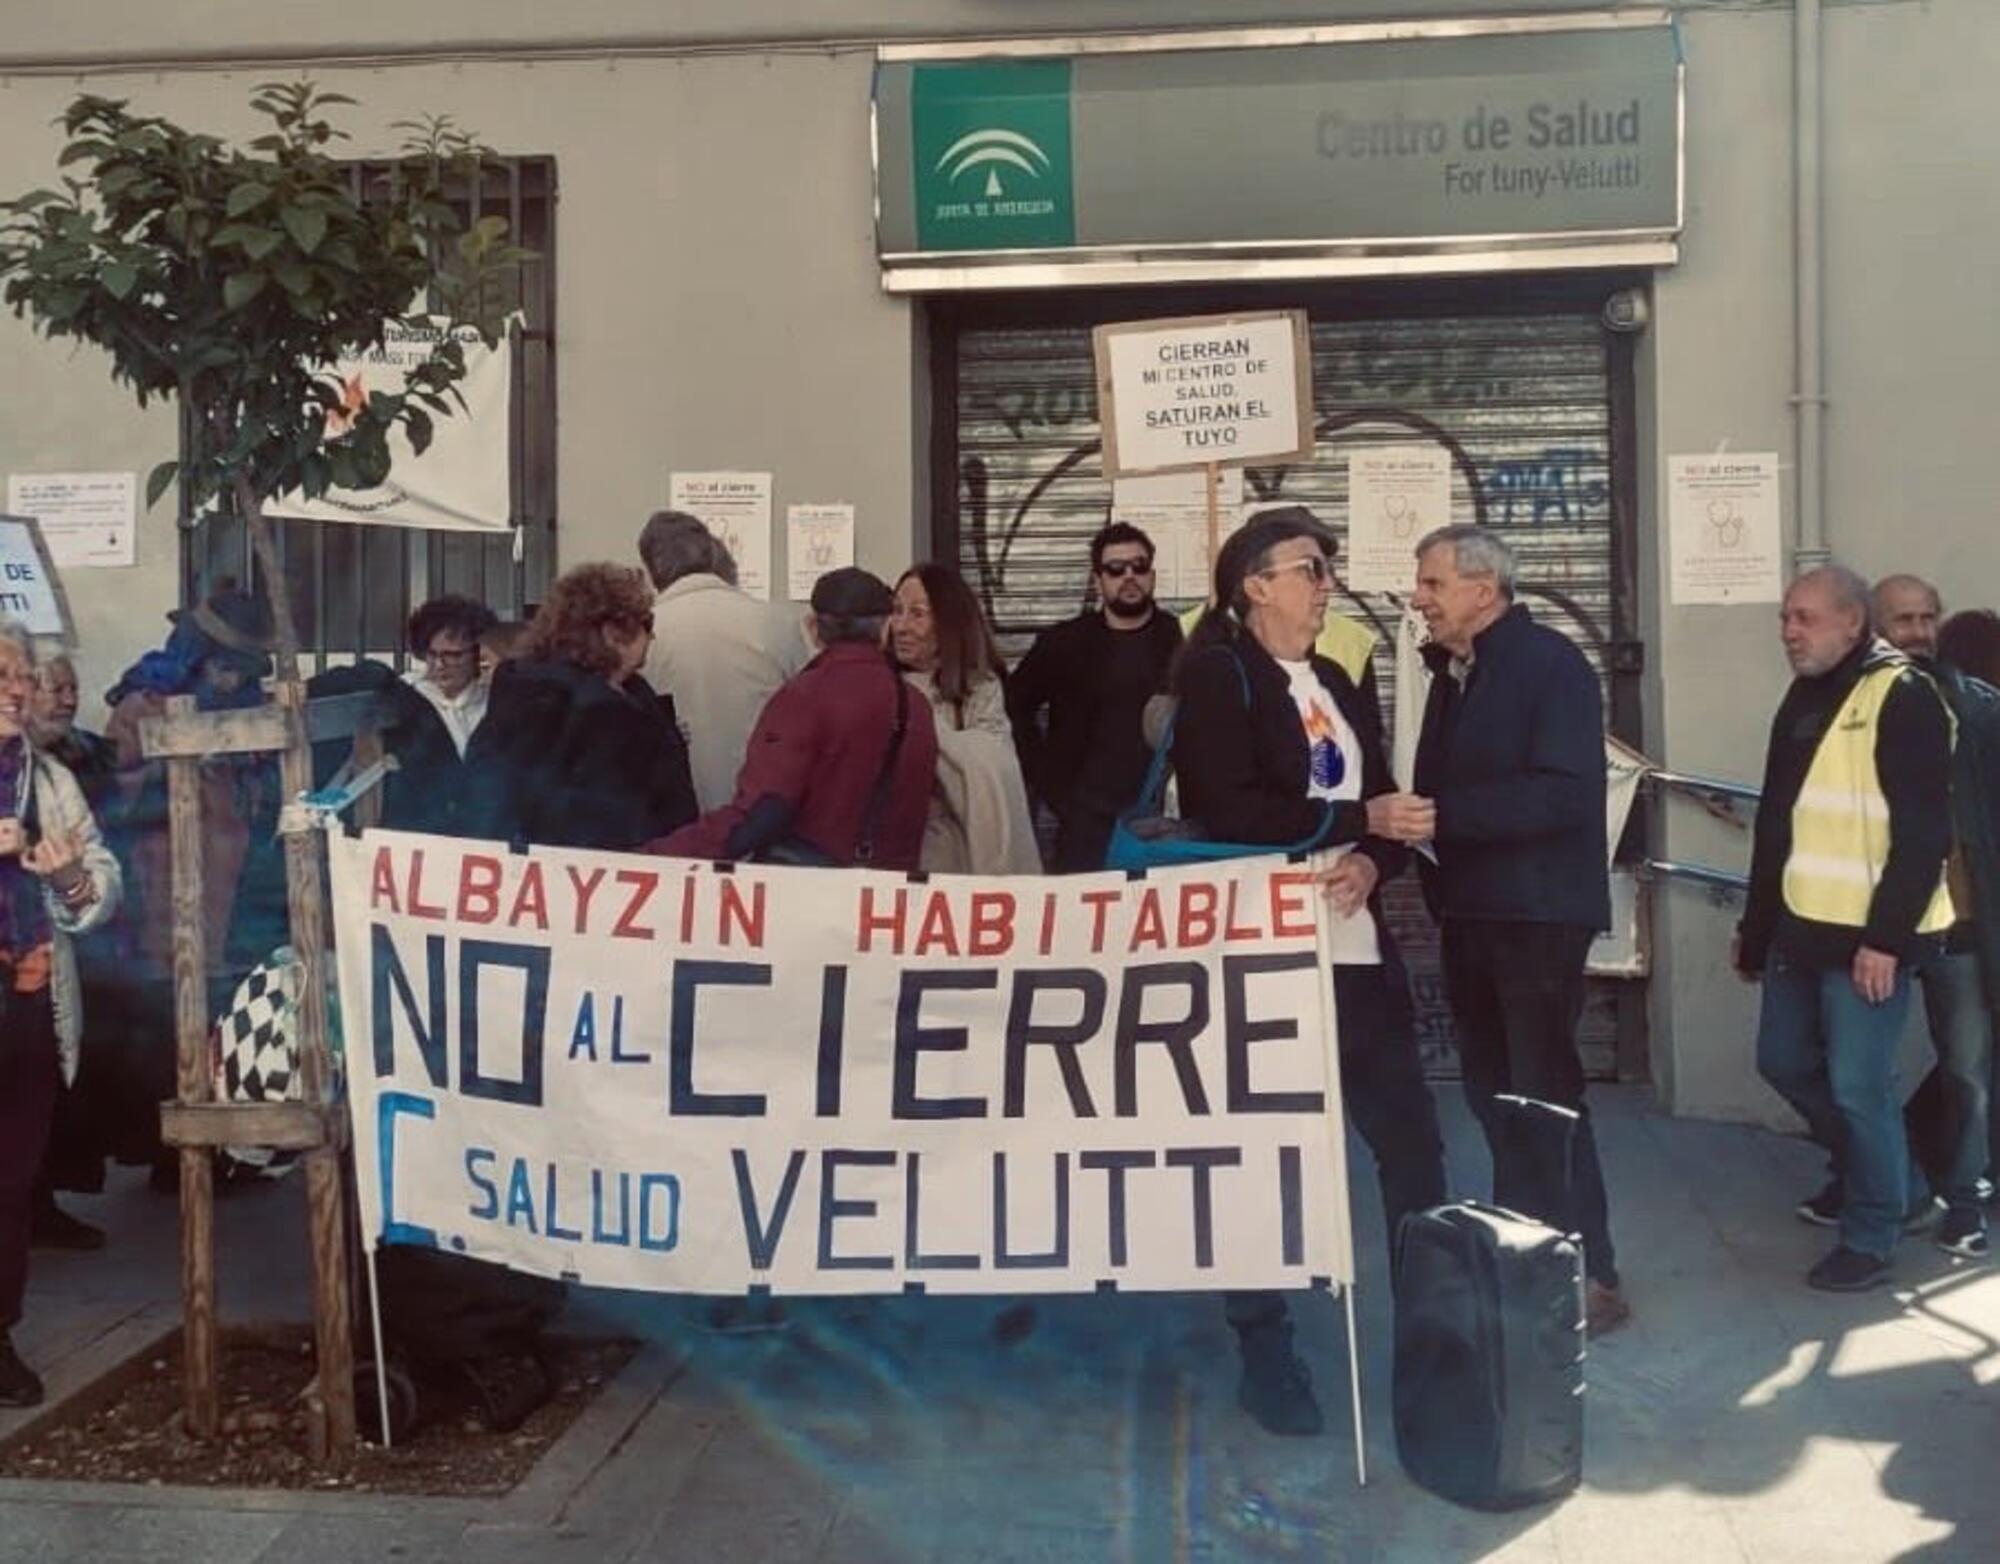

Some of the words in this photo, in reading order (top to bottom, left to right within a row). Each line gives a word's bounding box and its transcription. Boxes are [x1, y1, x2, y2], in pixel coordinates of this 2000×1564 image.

[1316, 110, 1446, 158] Centro
[1463, 106, 1510, 150] de
[1527, 99, 1640, 149] Salud
[1158, 337, 1250, 364] CIERRAN
[1142, 369, 1161, 384] MI
[1166, 362, 1238, 383] CENTRO
[1246, 359, 1269, 375] DE
[1146, 407, 1240, 429] SATURAN
[1246, 400, 1271, 418] EL
[1184, 426, 1237, 447] TUYO
[6, 563, 35, 581] DE
[369, 845, 766, 948] ALBAYZÍN
[856, 872, 1317, 956] HABITABLE
[371, 922, 551, 1107] NO
[568, 991, 650, 1063] AL
[669, 951, 1325, 1120] CIERRE
[465, 1148, 681, 1253] SALUD
[731, 1146, 1304, 1270] VELUTTI
